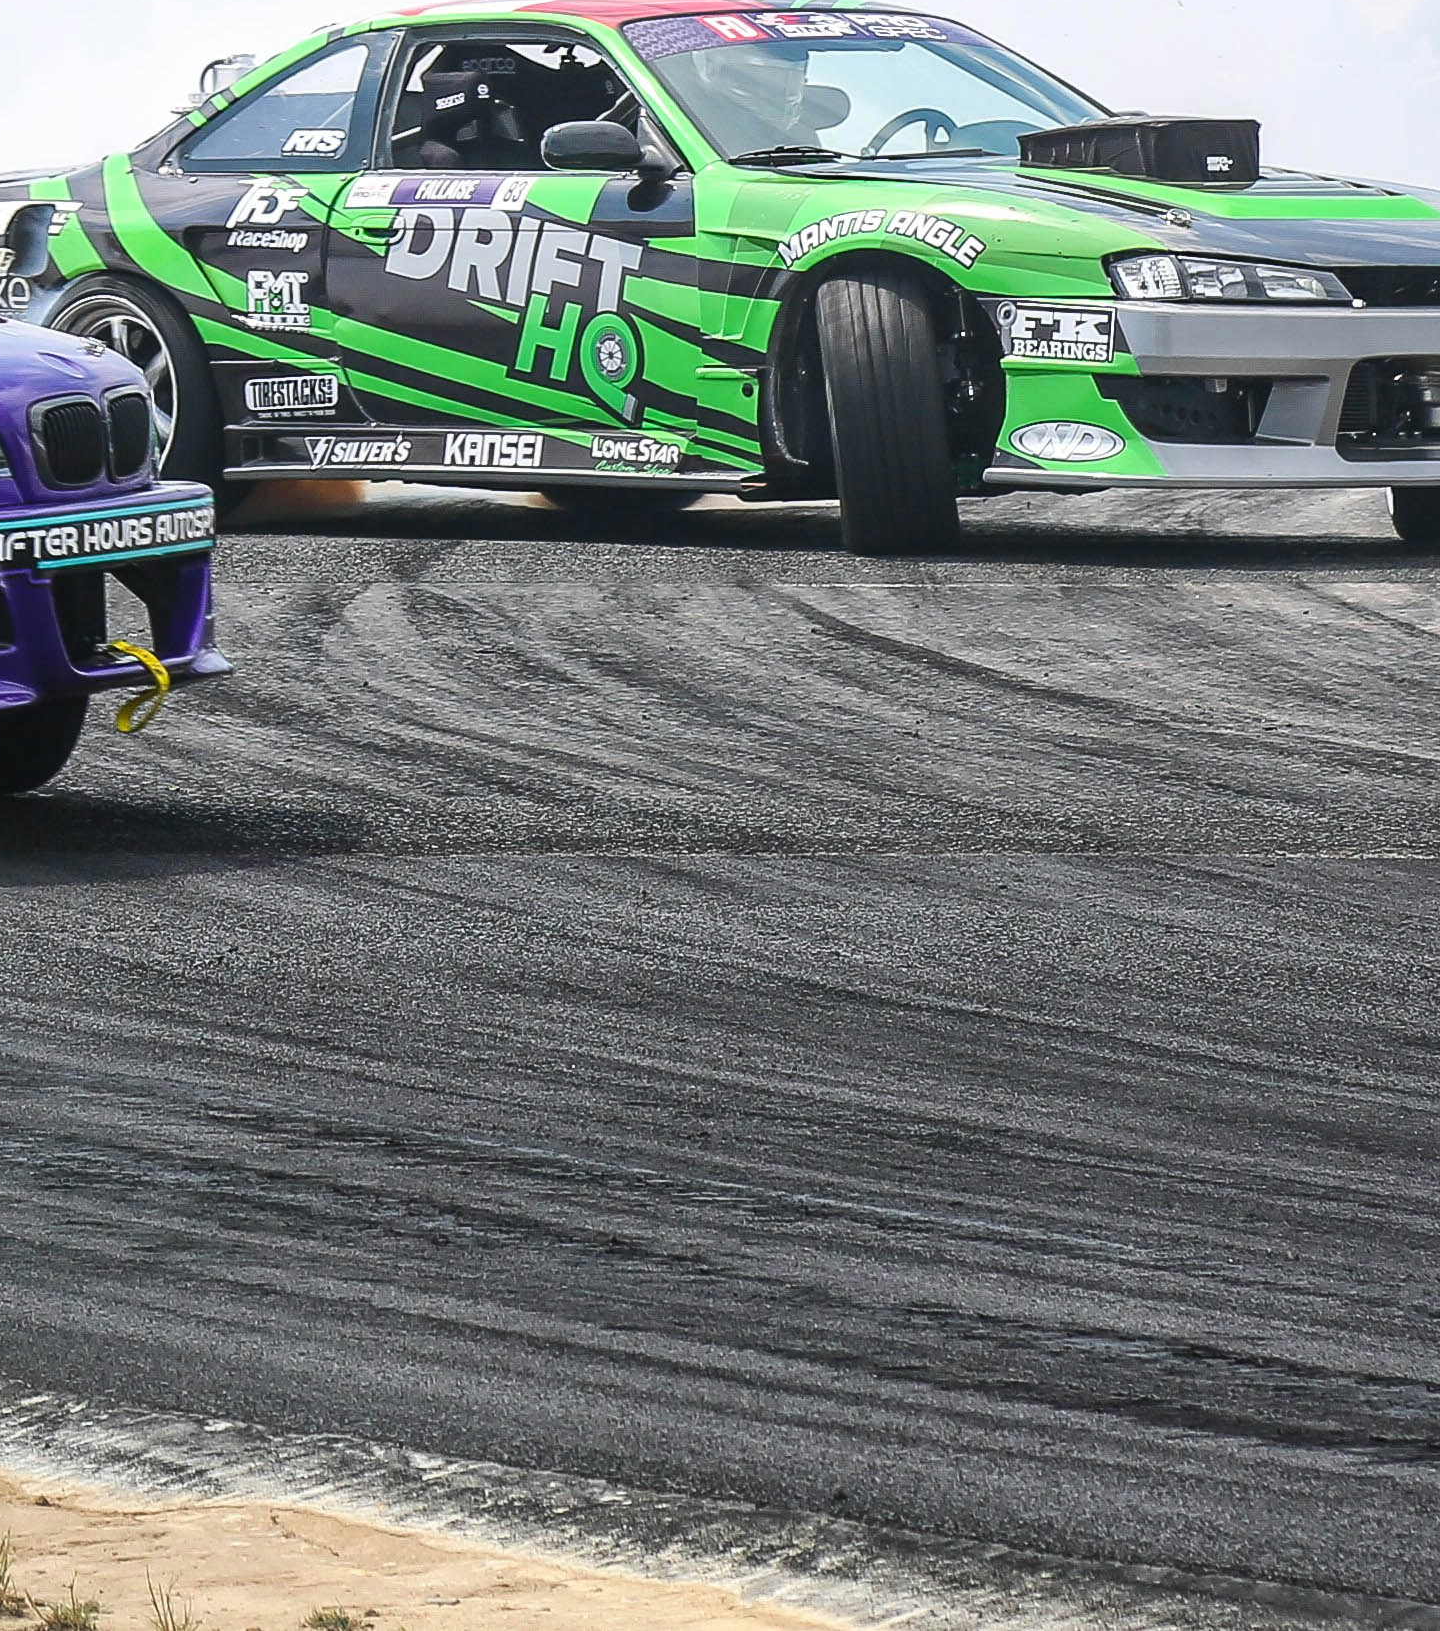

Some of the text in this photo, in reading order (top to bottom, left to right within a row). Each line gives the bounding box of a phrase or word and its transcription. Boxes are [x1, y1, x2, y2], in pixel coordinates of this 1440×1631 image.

[868, 25, 948, 40] SPEC
[282, 129, 346, 153] RTS
[414, 178, 481, 201] FALLAISE
[776, 209, 987, 269] MANTIS ANGLE
[384, 208, 644, 314] DRIFT
[1010, 309, 1109, 344] FK
[1011, 338, 1109, 362] BEARINGS
[249, 378, 327, 409] TIRESTACKS
[329, 433, 415, 465] SILVER'S
[443, 433, 544, 467] KANSEI
[82, 515, 153, 554] HOURS
